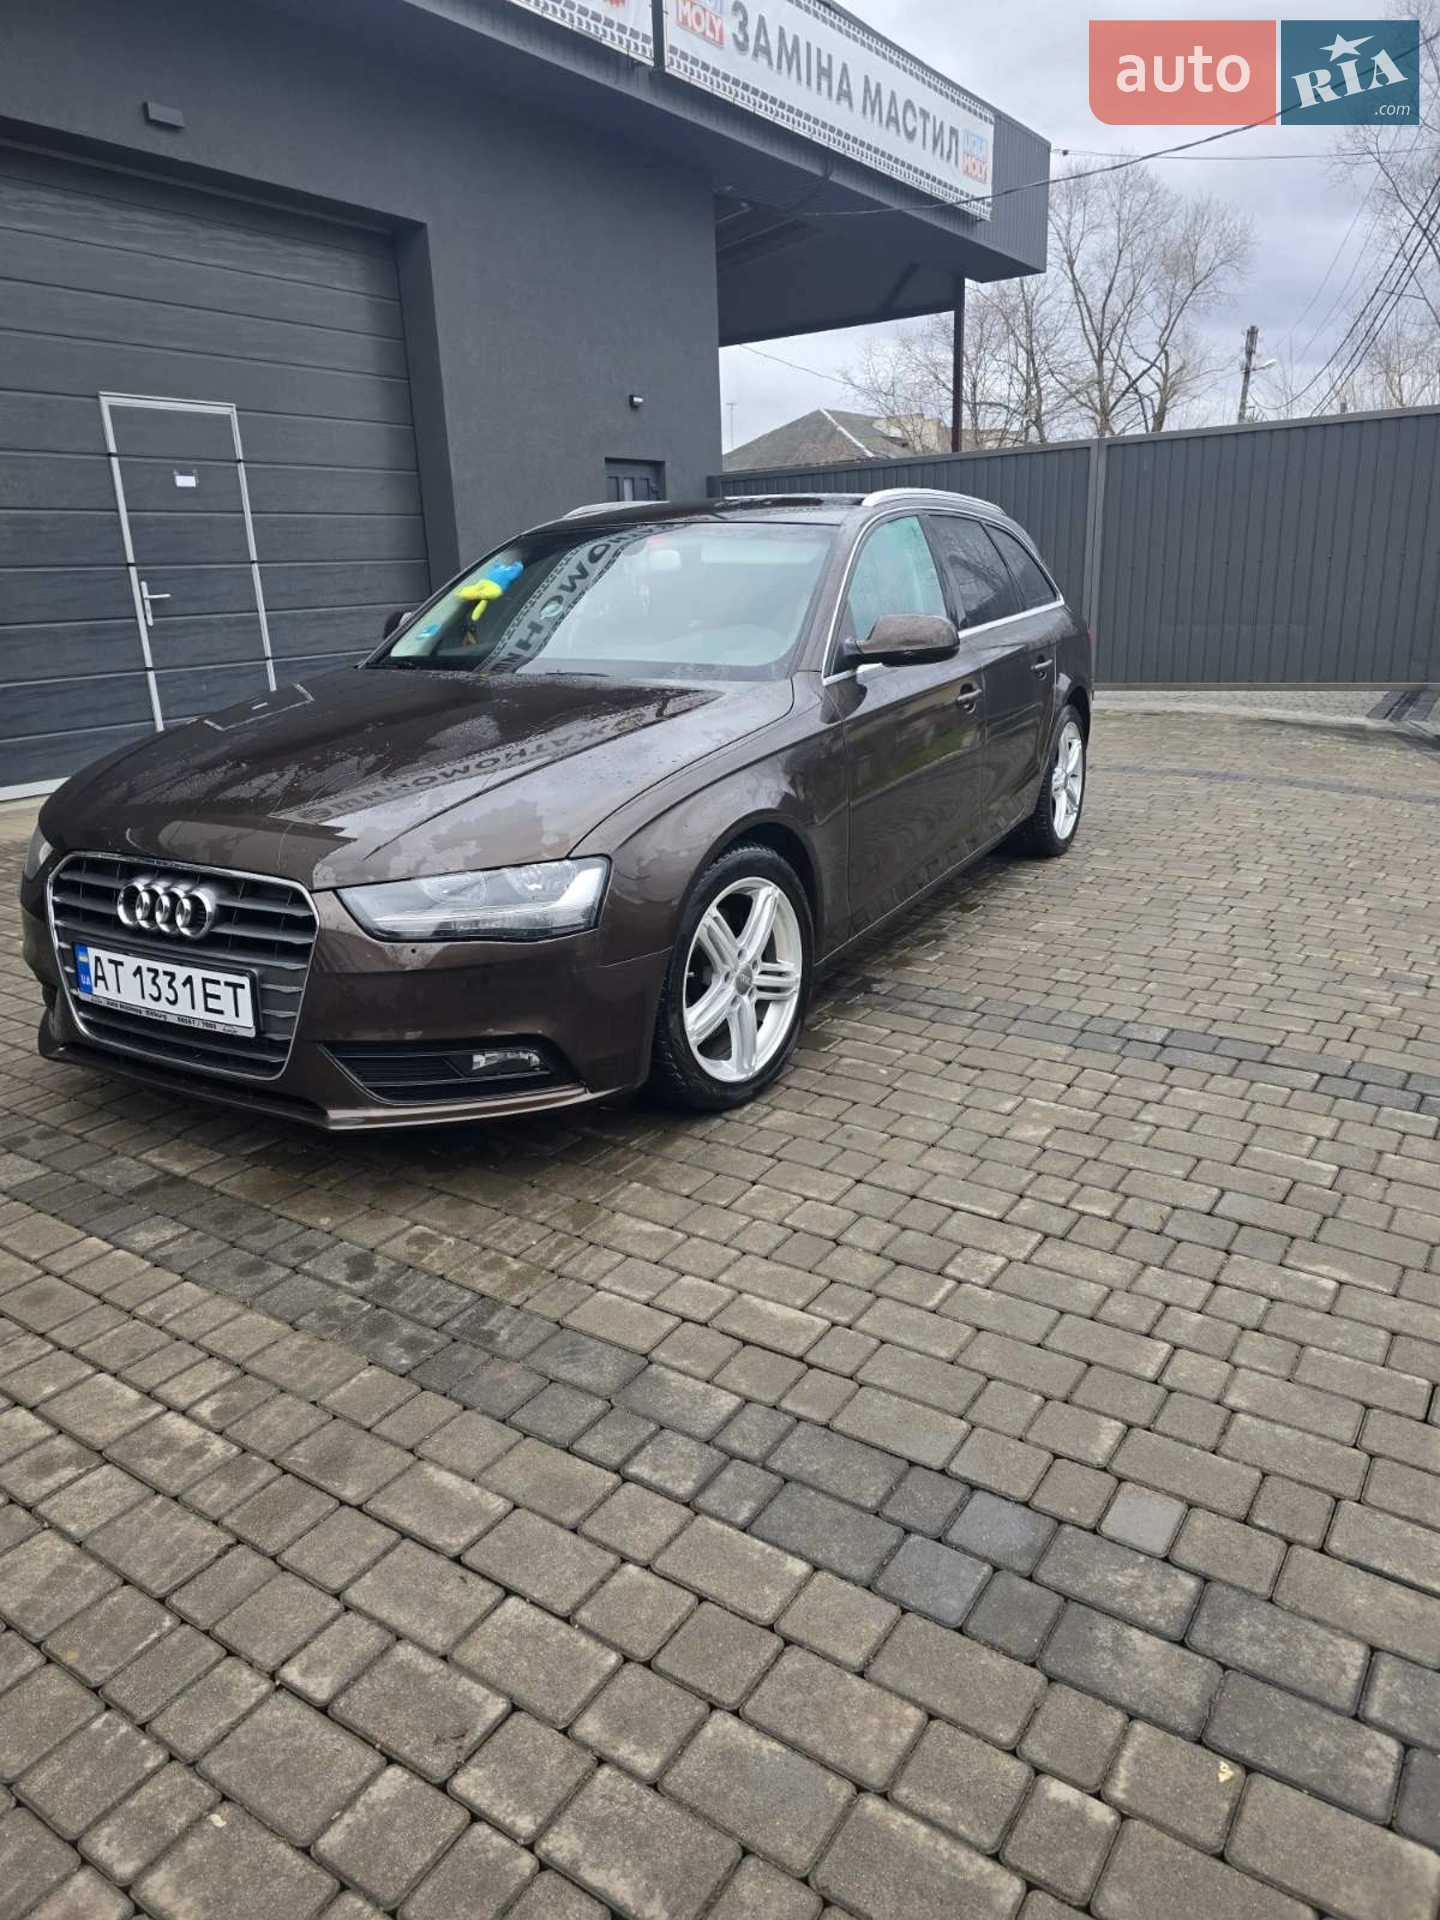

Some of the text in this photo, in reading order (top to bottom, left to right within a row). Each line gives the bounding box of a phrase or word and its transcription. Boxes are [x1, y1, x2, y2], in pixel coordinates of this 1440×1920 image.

[677, 0, 725, 45] MOLY
[731, 1, 960, 168] ЗАМІНА МАСТИЛ
[80, 974, 92, 987] UA
